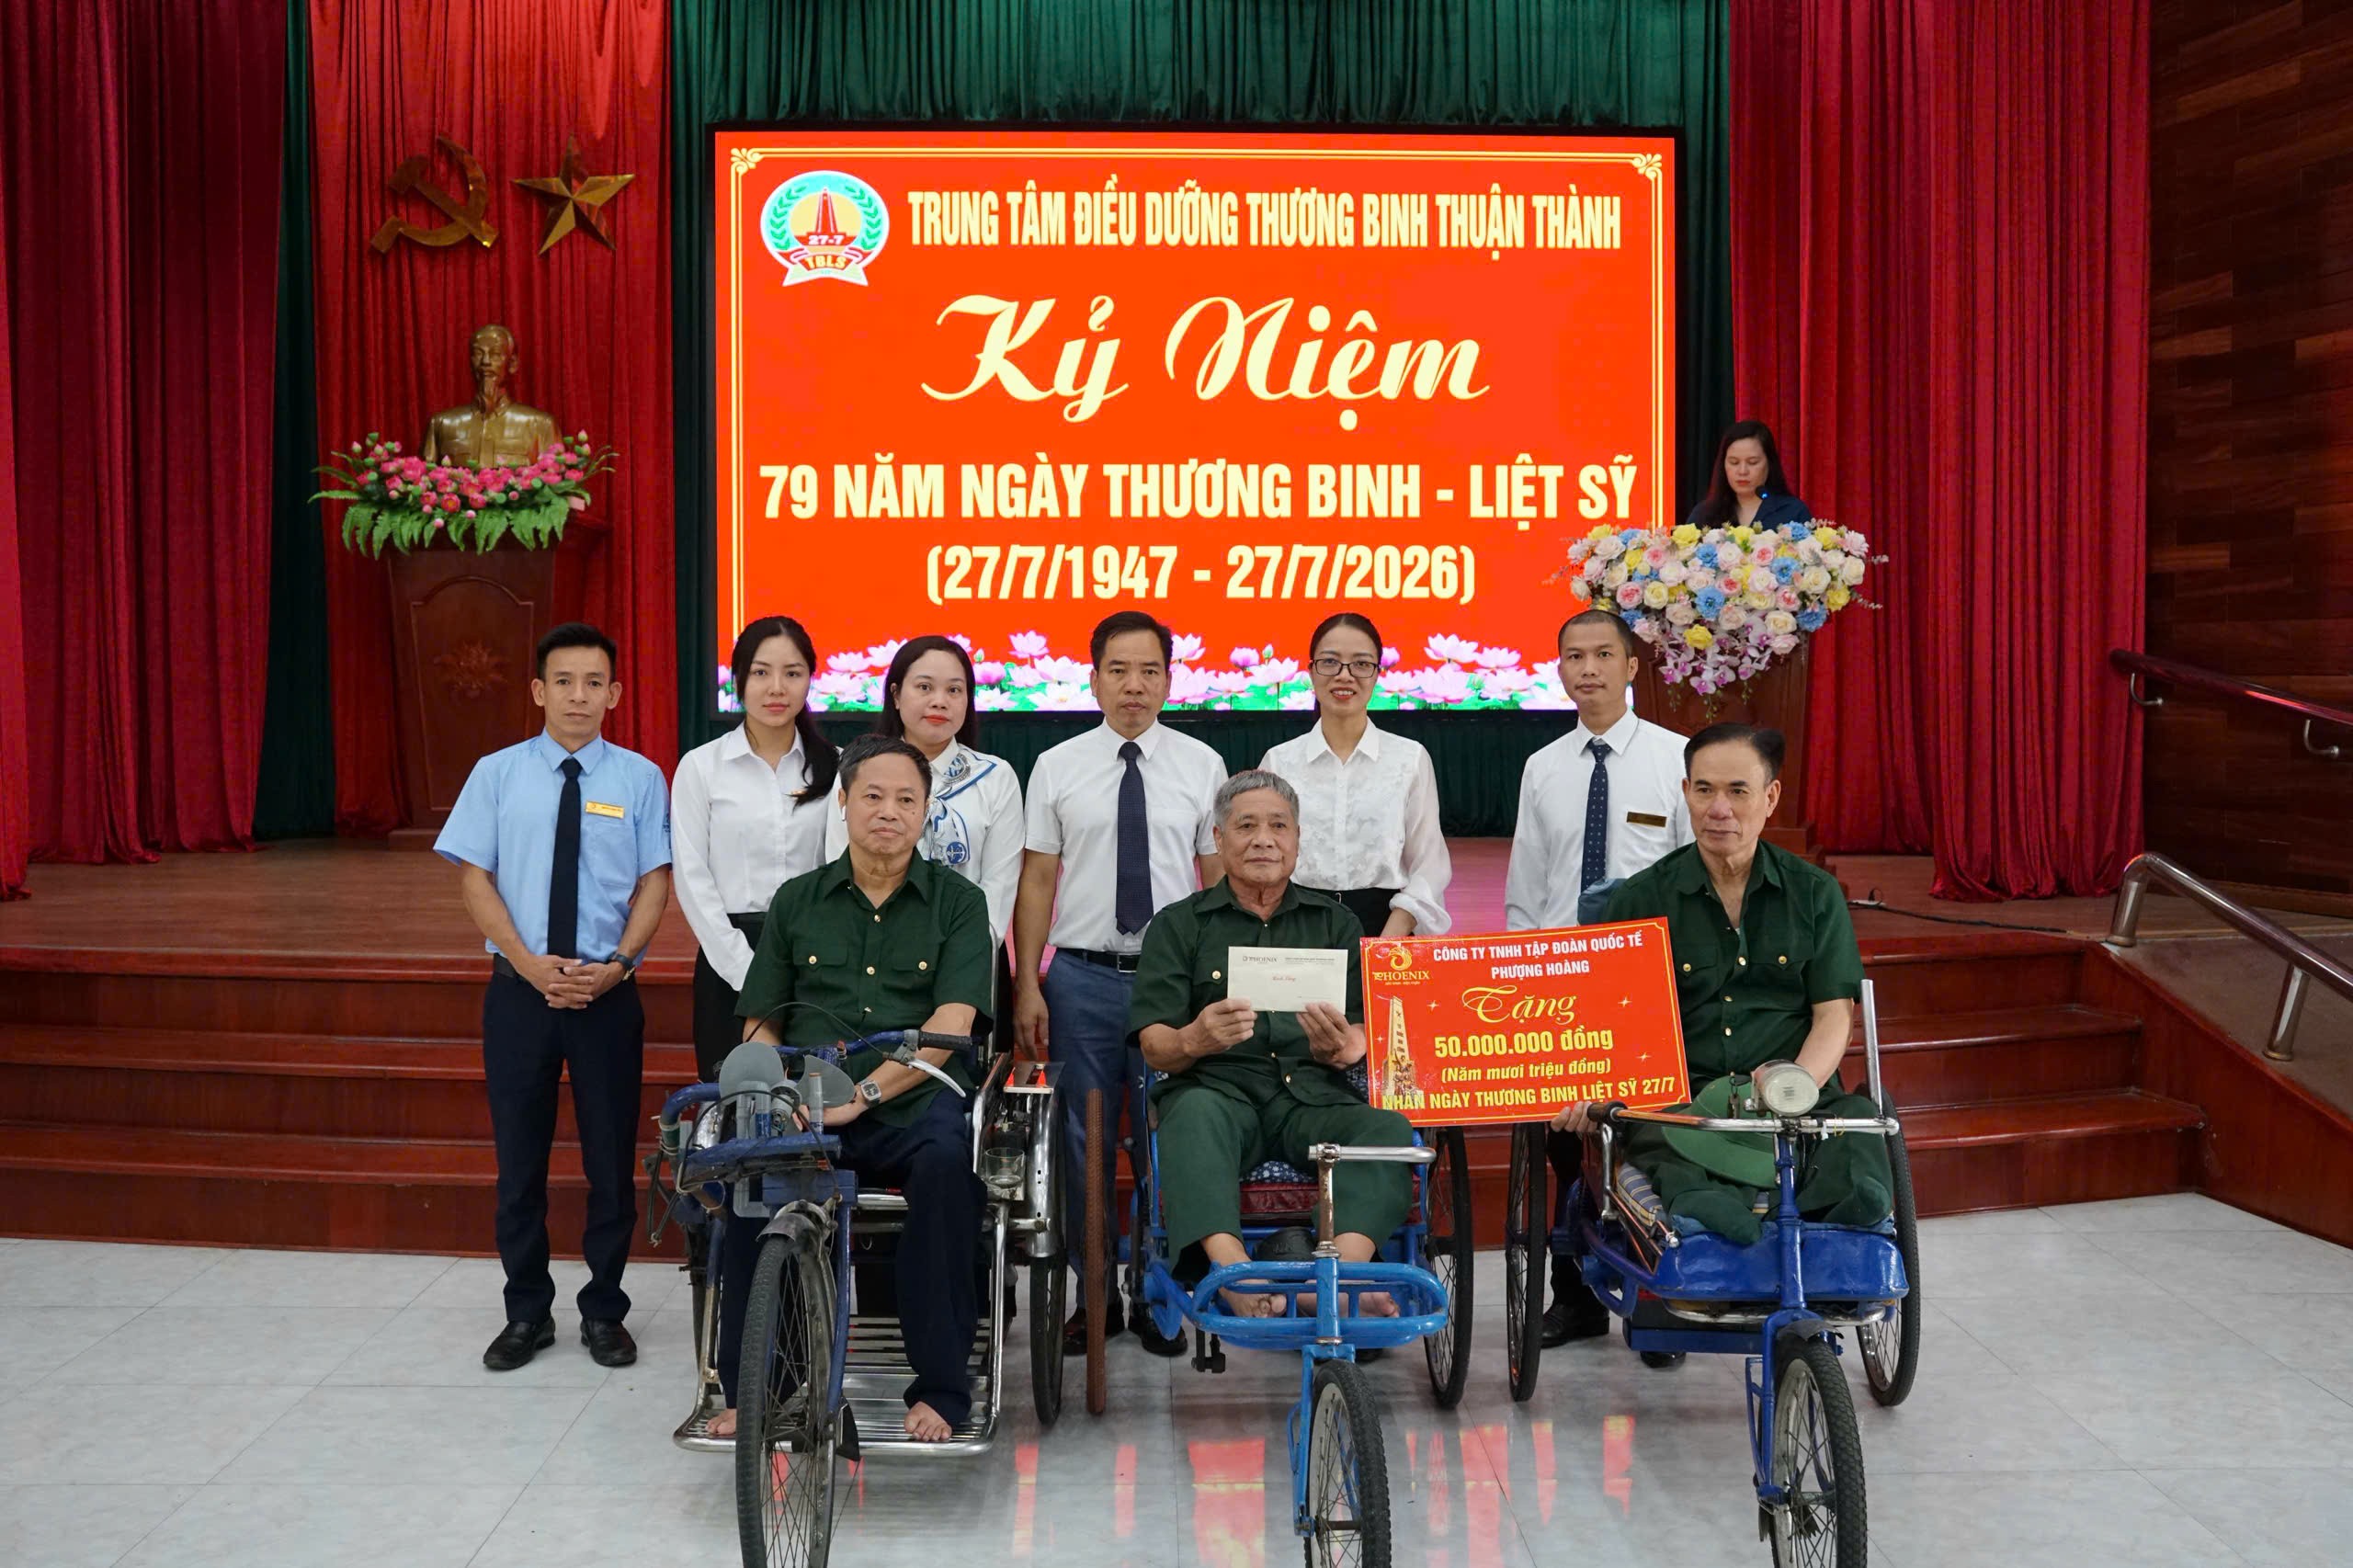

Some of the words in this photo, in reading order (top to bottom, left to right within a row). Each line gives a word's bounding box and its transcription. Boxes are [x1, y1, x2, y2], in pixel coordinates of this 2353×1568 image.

[907, 190, 999, 246] TRUNG
[1006, 180, 1066, 246] TÂM
[1073, 173, 1137, 246] ĐIỀU
[1145, 179, 1239, 247] DƯỠNG
[1246, 187, 1355, 248] THƯƠNG
[1363, 193, 1428, 247] BINH
[1436, 182, 1525, 260] THUẬN
[1532, 184, 1621, 249] THÀNH
[809, 234, 844, 245] 27-7
[803, 255, 847, 269] TBLS
[921, 294, 1129, 423] Kỷ
[1165, 296, 1490, 431] Niệm
[759, 464, 819, 519] 79
[834, 452, 945, 518] NĂM
[961, 451, 1089, 519] NGÀY
[1102, 458, 1292, 519] THƯƠNG
[1307, 463, 1421, 518] BINH
[1436, 490, 1454, 501] -
[1470, 452, 1564, 530] LIỆT
[1577, 452, 1636, 519] SỸ
[926, 543, 1178, 606] (27/7/1947
[1193, 570, 1211, 581] -
[1225, 543, 1475, 606] 27/7/2026)
[1433, 947, 1468, 961] CÔNG
[1471, 947, 1485, 960] TY
[1489, 945, 1522, 959] TNHH
[1525, 941, 1549, 959] TẬP
[1552, 937, 1587, 955] ĐOÀN
[1591, 932, 1624, 951] QUỐC
[1627, 929, 1643, 947] TẾ
[1372, 971, 1430, 981] PHOENIX
[1491, 964, 1543, 981] PHƯỢNG
[1546, 960, 1590, 976] HOÀNG
[1461, 984, 1577, 1025] Tặng
[1434, 1030, 1554, 1058] 50.000.000
[1560, 1025, 1614, 1051] đồng
[1441, 1067, 1482, 1083] (Năm
[1486, 1063, 1525, 1080] mươi
[1529, 1062, 1563, 1079] triệu
[1568, 1058, 1611, 1074] đồng)
[1430, 1089, 1470, 1109] NGÀY
[1475, 1087, 1536, 1108] THƯƠNG
[1540, 1085, 1578, 1104] BINH
[1582, 1081, 1613, 1103] LIỆT
[1618, 1077, 1638, 1097] SỸ
[1642, 1076, 1676, 1095] 27/7
